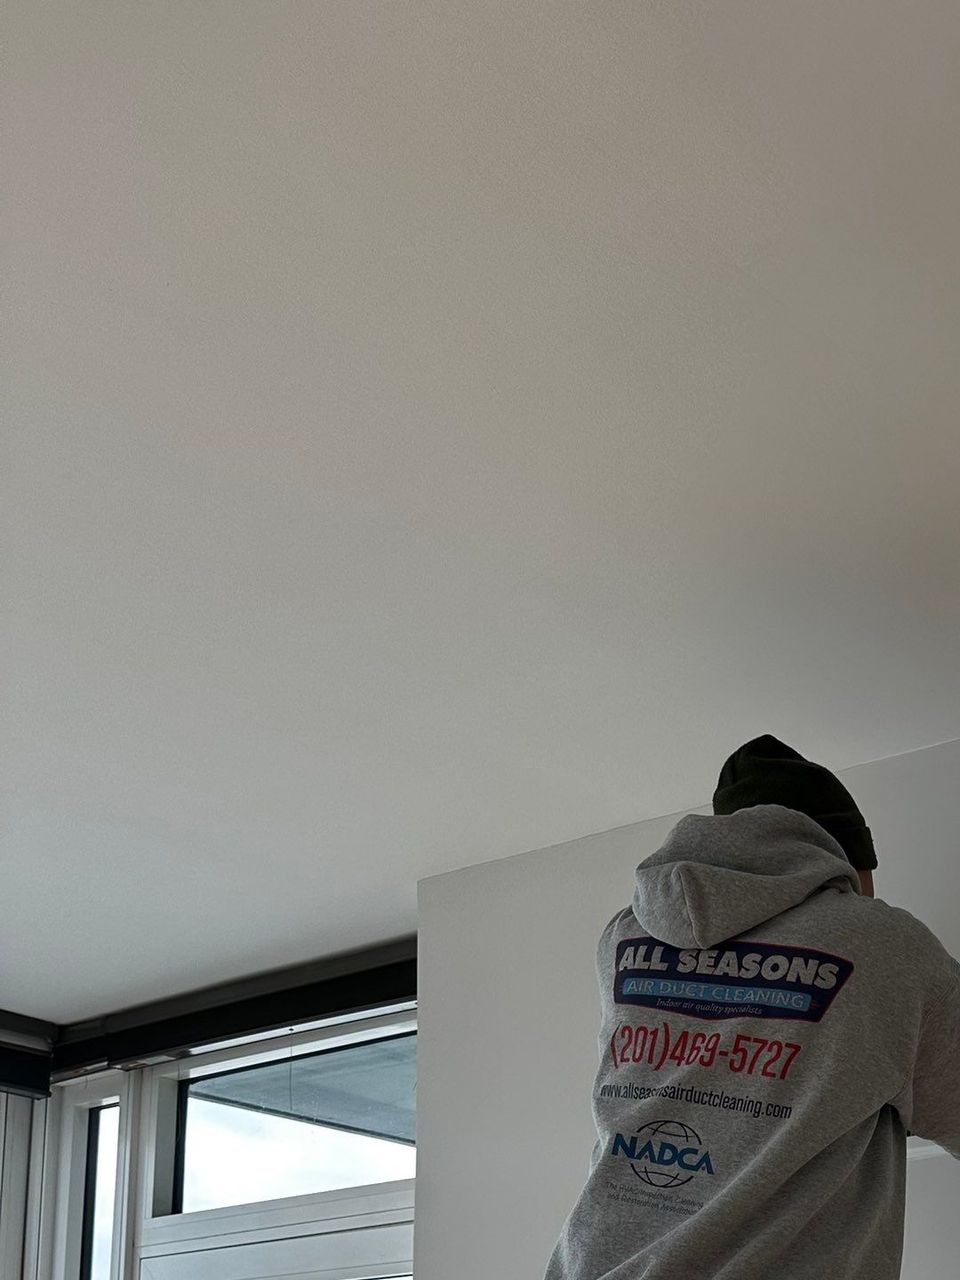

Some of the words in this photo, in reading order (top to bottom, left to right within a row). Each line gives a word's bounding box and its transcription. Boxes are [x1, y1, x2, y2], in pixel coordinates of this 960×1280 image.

[618, 945, 669, 972] ALL
[676, 949, 840, 989] SEASONS
[627, 981, 655, 993] AIR
[660, 983, 709, 998] DUCT
[711, 987, 805, 1008] CLEANING
[656, 998, 682, 1008] Indoor
[682, 1001, 694, 1010] air
[695, 1002, 724, 1014] quality
[610, 1021, 801, 1080] (201)469-5727
[600, 1082, 792, 1120] www.allseansairductcleaning.com
[611, 1133, 715, 1175] NADCA
